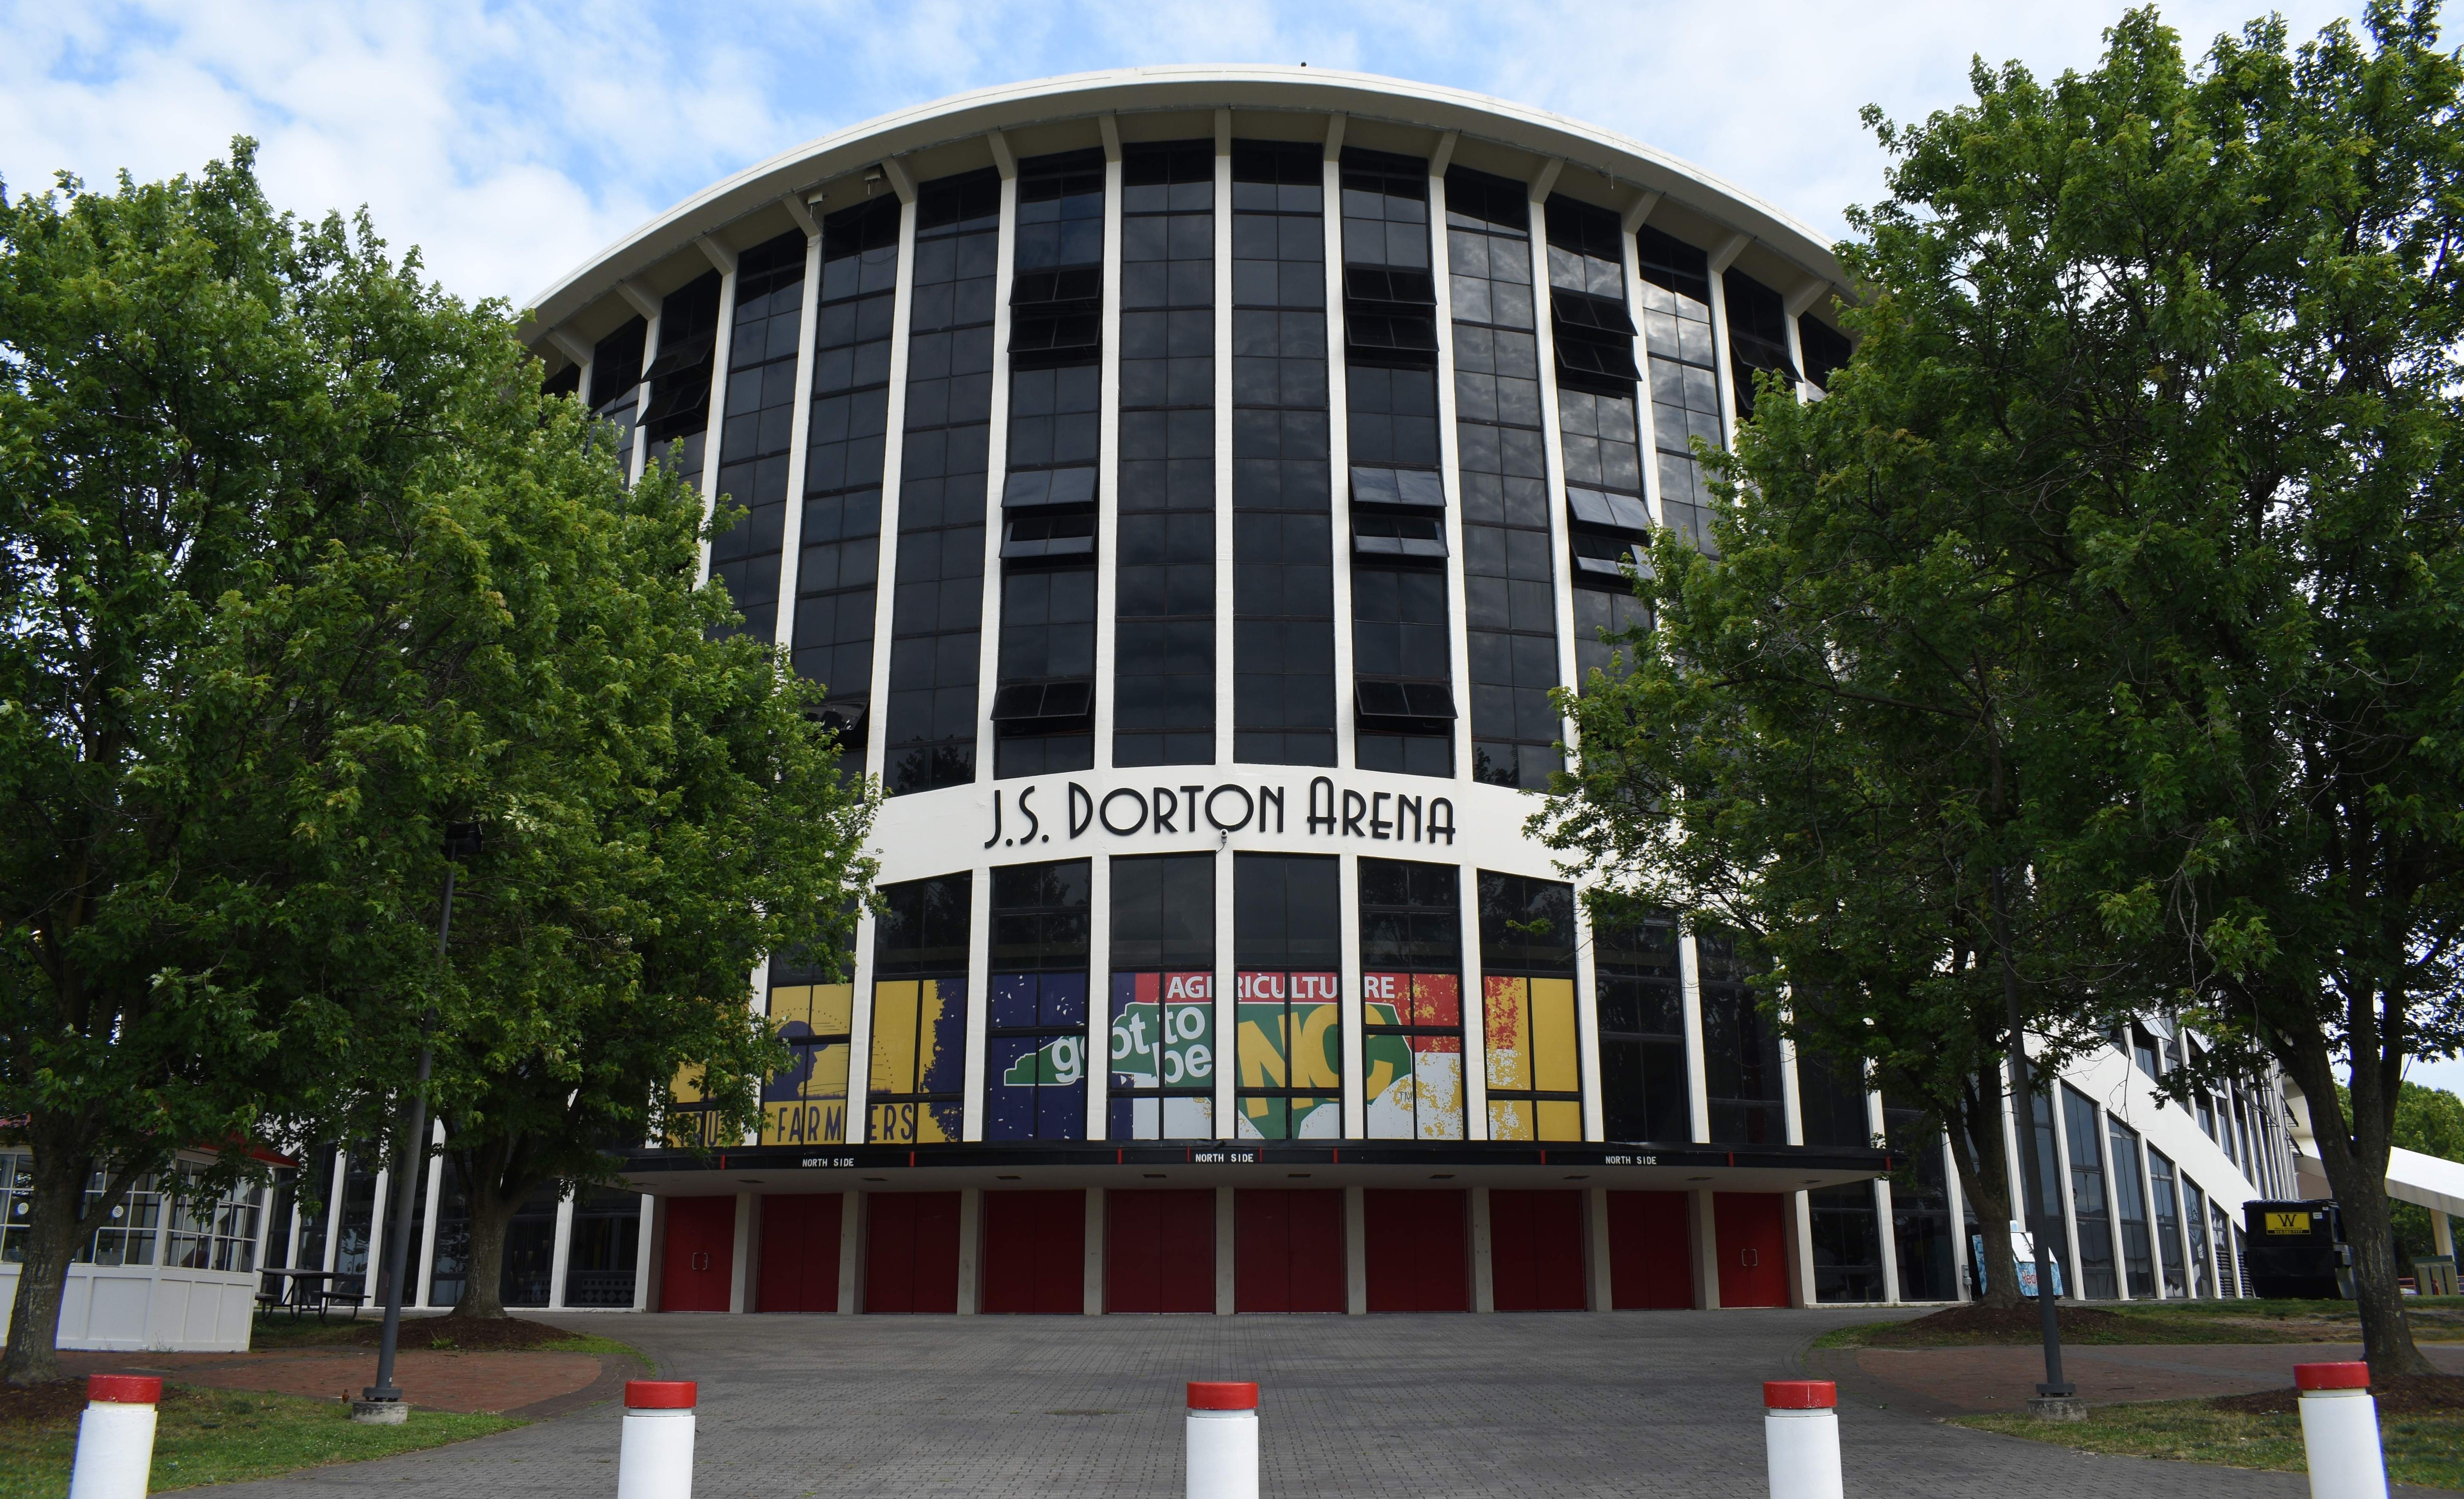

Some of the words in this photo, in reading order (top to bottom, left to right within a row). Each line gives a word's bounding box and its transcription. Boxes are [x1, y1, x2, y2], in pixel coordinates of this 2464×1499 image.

[984, 785, 1049, 849] J.S.
[1068, 781, 1284, 839] DORTON
[1307, 775, 1456, 845] ARENA
[1167, 976, 1395, 999] AGRICULTURE
[1051, 1011, 1150, 1083] got
[1157, 1006, 1206, 1045] to
[1152, 1041, 1212, 1084] be
[1238, 1004, 1394, 1119] NC
[777, 1103, 914, 1142] FARMERS
[802, 1158, 828, 1168] NORTH
[834, 1157, 854, 1167] SIDE
[1195, 1153, 1224, 1163] NORTH
[1231, 1153, 1254, 1163] SIDE
[1605, 1155, 1631, 1164] NORTH
[1637, 1156, 1657, 1165] SIDE
[2278, 1214, 2296, 1227] W
